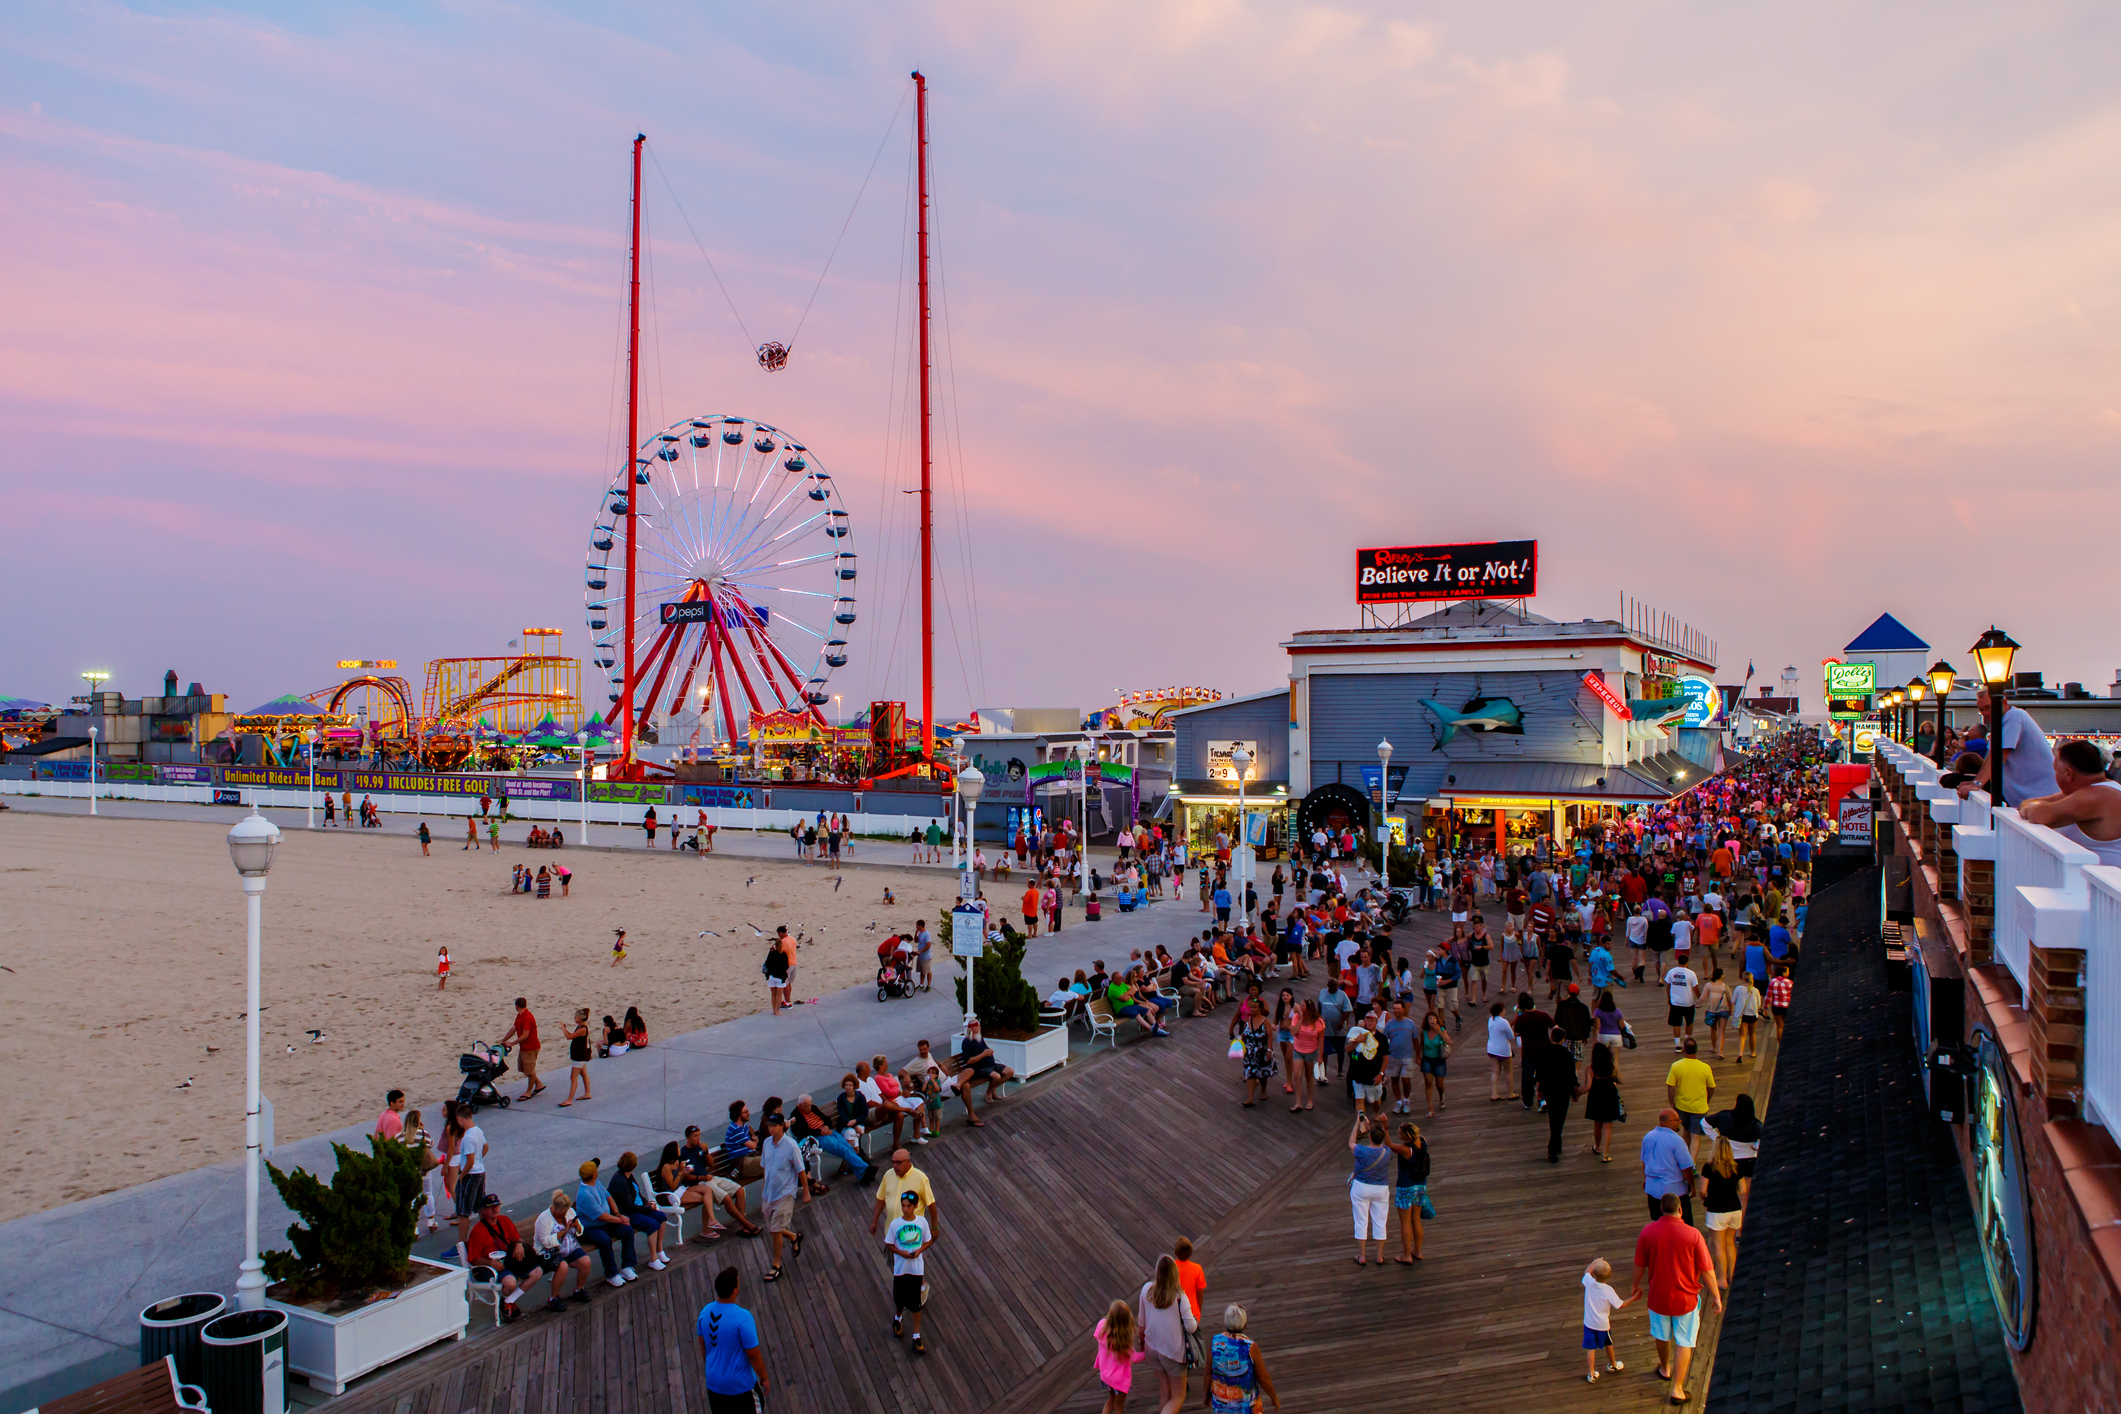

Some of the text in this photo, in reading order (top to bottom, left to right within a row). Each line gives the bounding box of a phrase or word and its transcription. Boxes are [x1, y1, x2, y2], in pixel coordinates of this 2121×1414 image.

[1360, 558, 1529, 585] Believe It or Not!
[1458, 579, 1519, 587] MUSEUM
[1400, 591, 1417, 599] THE
[1418, 590, 1448, 598] WHOLE
[1450, 589, 1484, 597] FAMILY!
[678, 606, 704, 619] pepsi
[375, 660, 397, 669] STAR
[1588, 677, 1624, 713] ENTRANCE
[980, 760, 1007, 775] Jolly
[1209, 768, 1215, 779] 2
[224, 770, 266, 784] Unlimited
[269, 772, 292, 785] Rides
[294, 772, 311, 785] Arm
[315, 773, 338, 786] Band
[356, 774, 384, 788] $19.99
[388, 776, 435, 791] INCLUDES
[437, 778, 461, 792] FREE
[464, 779, 489, 794] GOLF
[505, 780, 517, 788] Good
[533, 781, 553, 789] locations
[1841, 803, 1871, 822] Atlantic
[1841, 822, 1871, 832] HOTEL
[1663, 873, 1675, 883] 25
